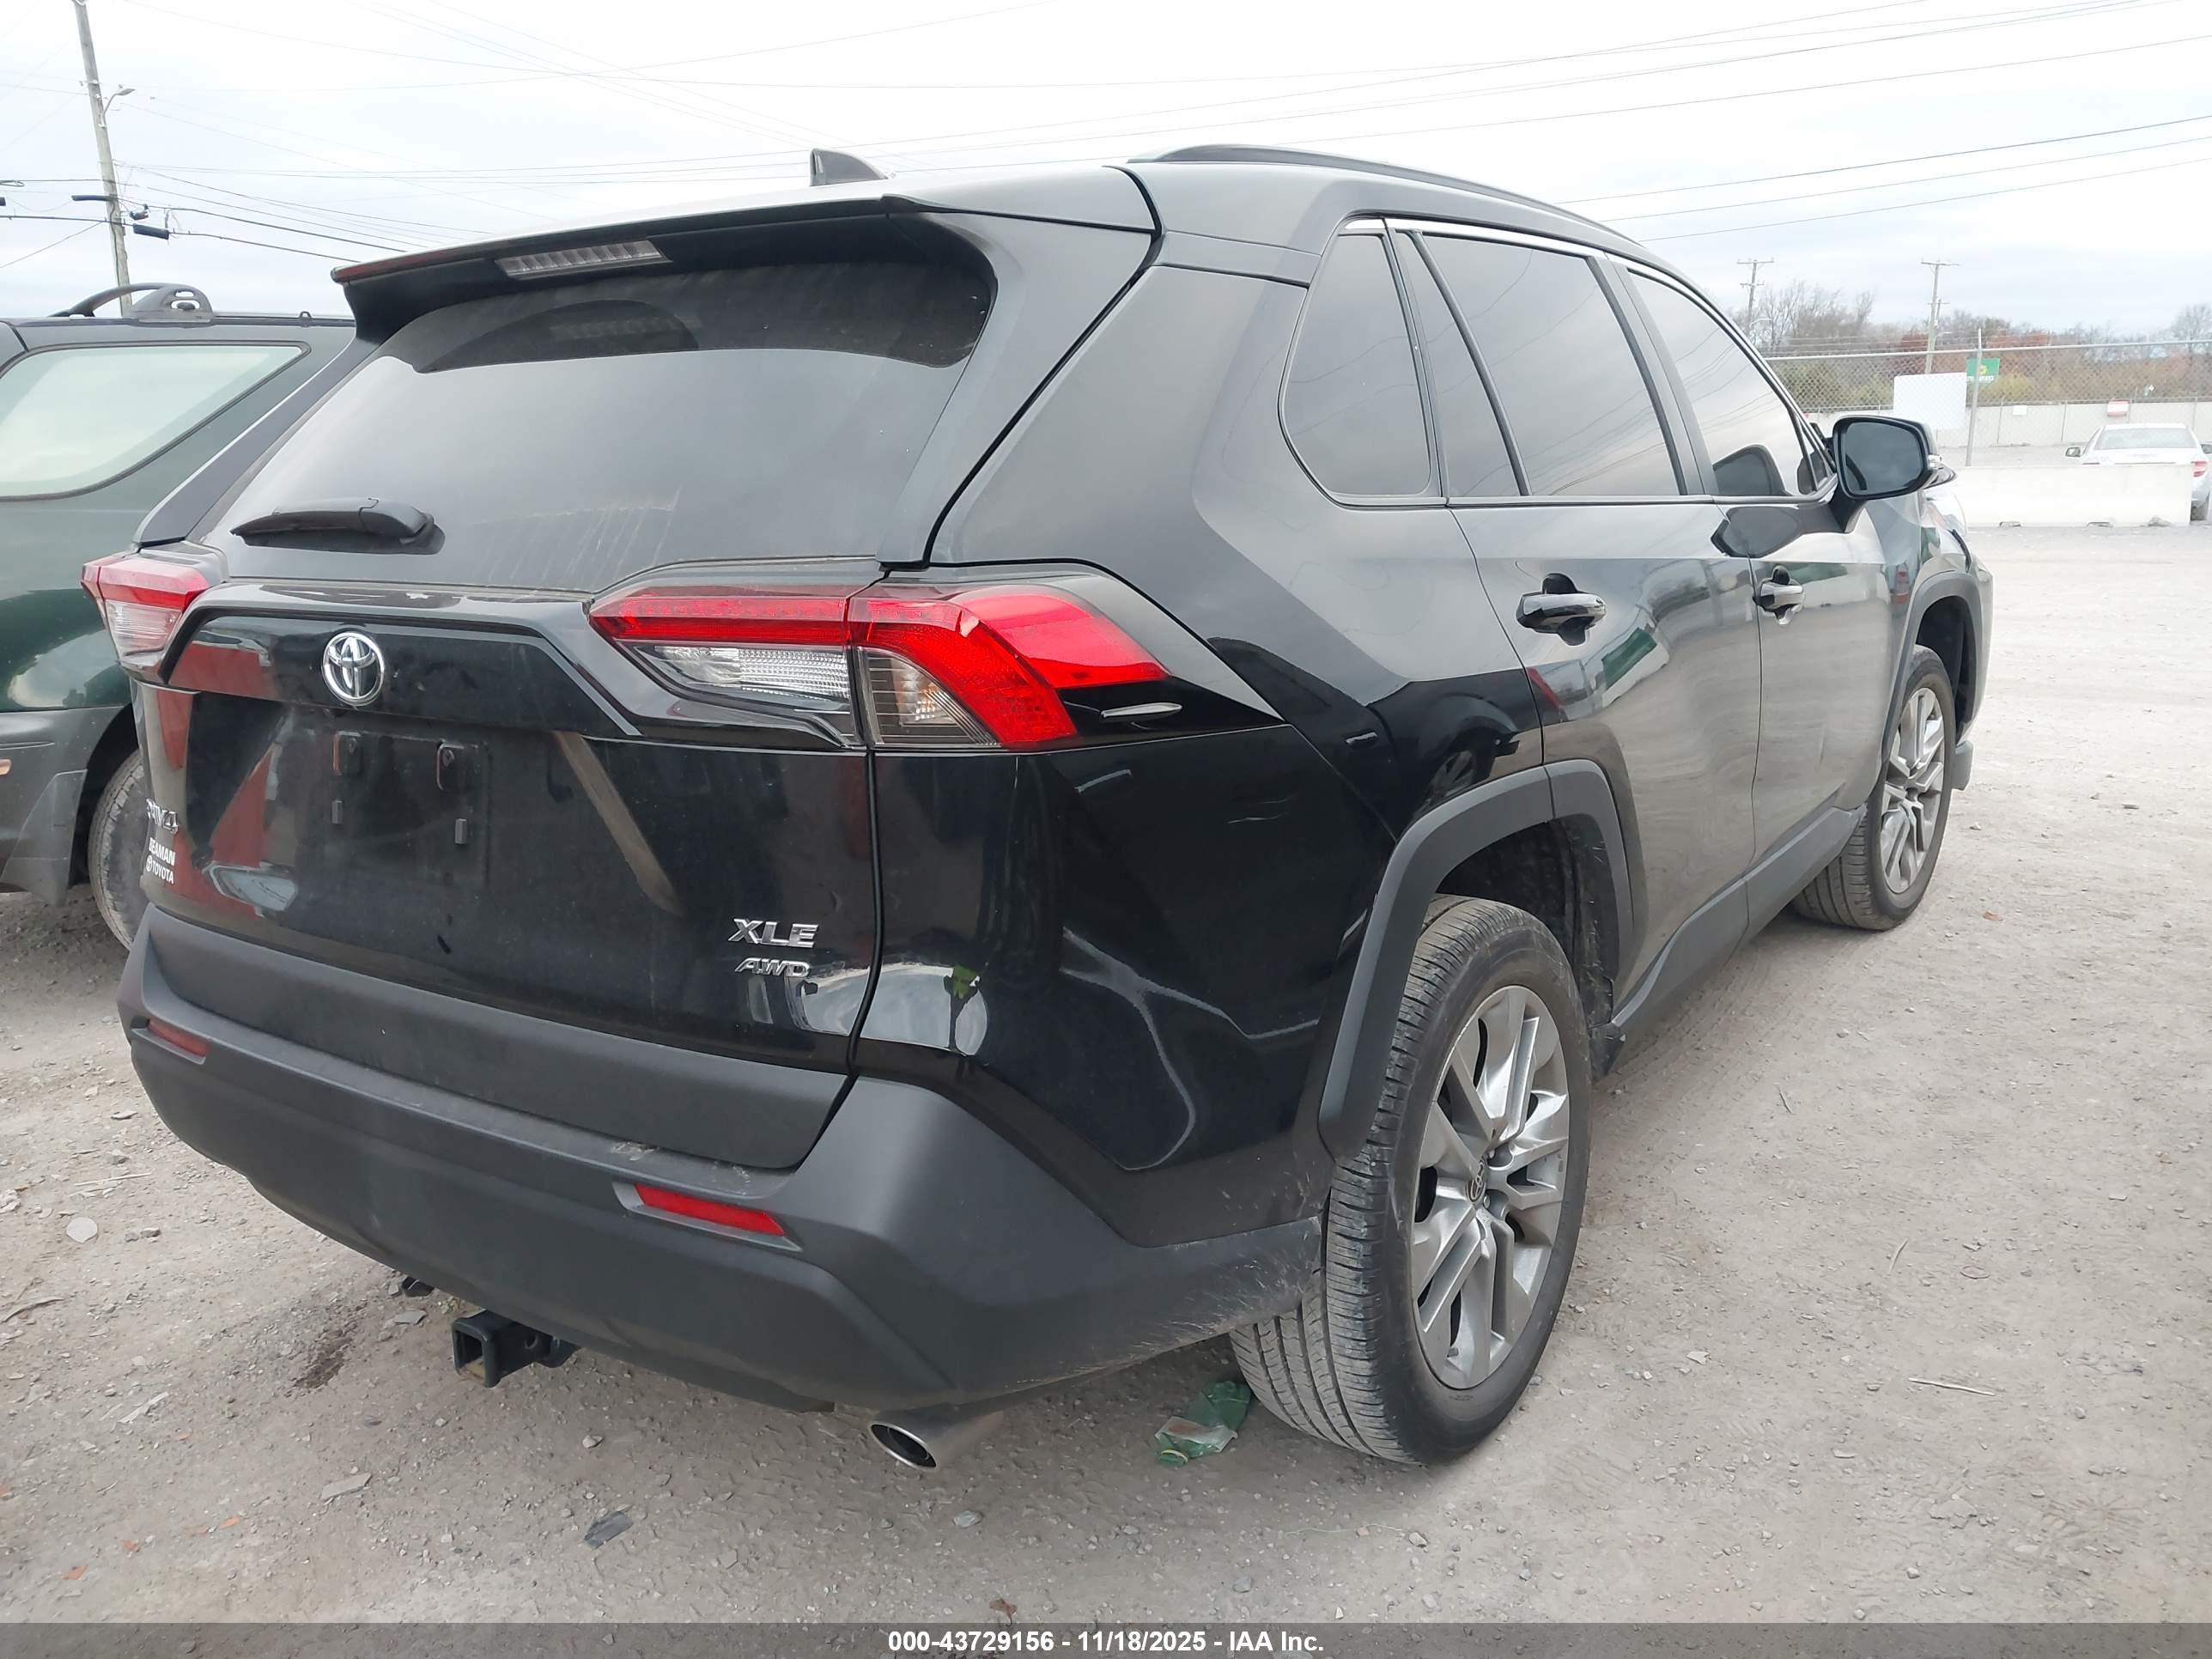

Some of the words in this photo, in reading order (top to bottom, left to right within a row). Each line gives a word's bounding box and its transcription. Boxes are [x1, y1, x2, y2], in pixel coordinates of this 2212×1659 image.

[149, 836, 176, 866] BEAMAN
[151, 860, 174, 884] TOYOTA
[728, 918, 818, 948] XLE
[735, 957, 811, 977] AWD
